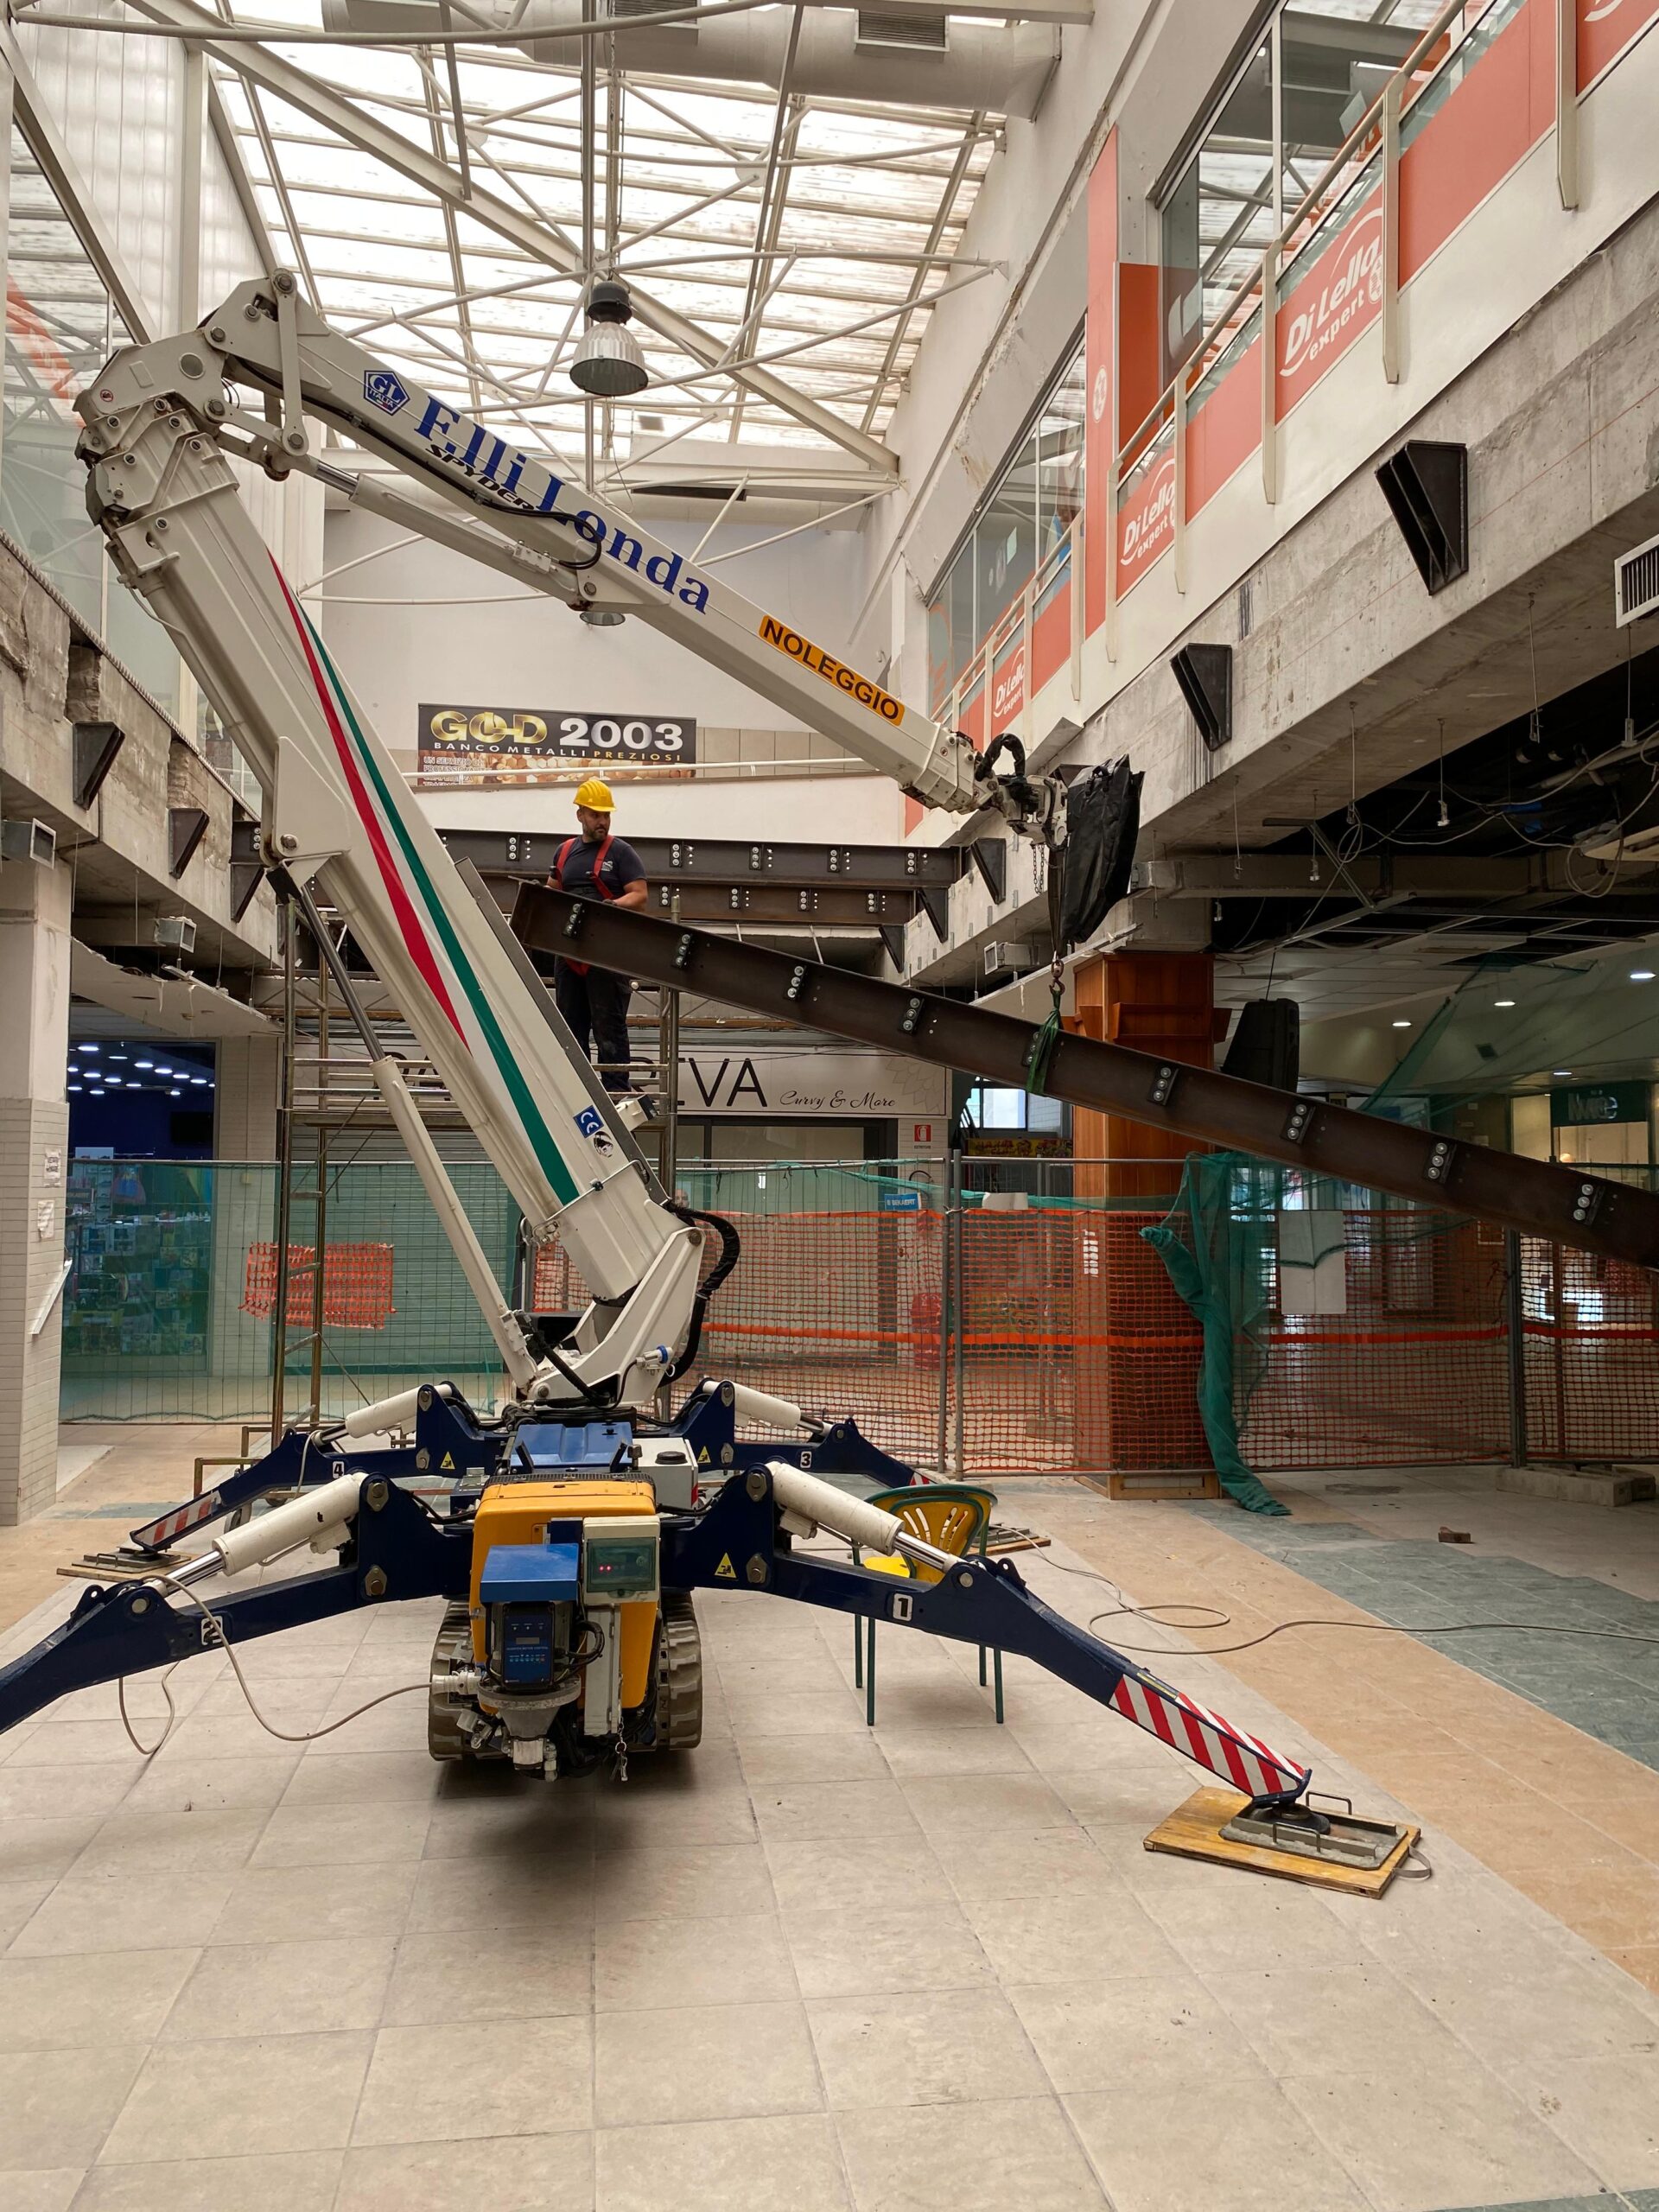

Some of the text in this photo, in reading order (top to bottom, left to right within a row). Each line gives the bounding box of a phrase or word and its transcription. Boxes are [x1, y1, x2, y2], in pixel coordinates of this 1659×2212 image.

[1309, 288, 1364, 360] expert
[369, 374, 401, 404] GL
[369, 388, 394, 408] ITALIA
[425, 444, 536, 511] SPYDER
[536, 474, 710, 615] Londa
[1137, 515, 1168, 558] expert
[763, 619, 899, 720] NOLEGGIO
[430, 710, 683, 752] GOLD 2003
[434, 741, 681, 762] BANCO METALLI PREZIOSI
[779, 1090, 826, 1110] Curvy
[830, 1090, 846, 1109] &
[849, 1091, 896, 1110] More
[334, 1463, 344, 1477] 4
[802, 1452, 811, 1466] 3
[898, 1598, 909, 1618] 1
[203, 1619, 222, 1643] 2
